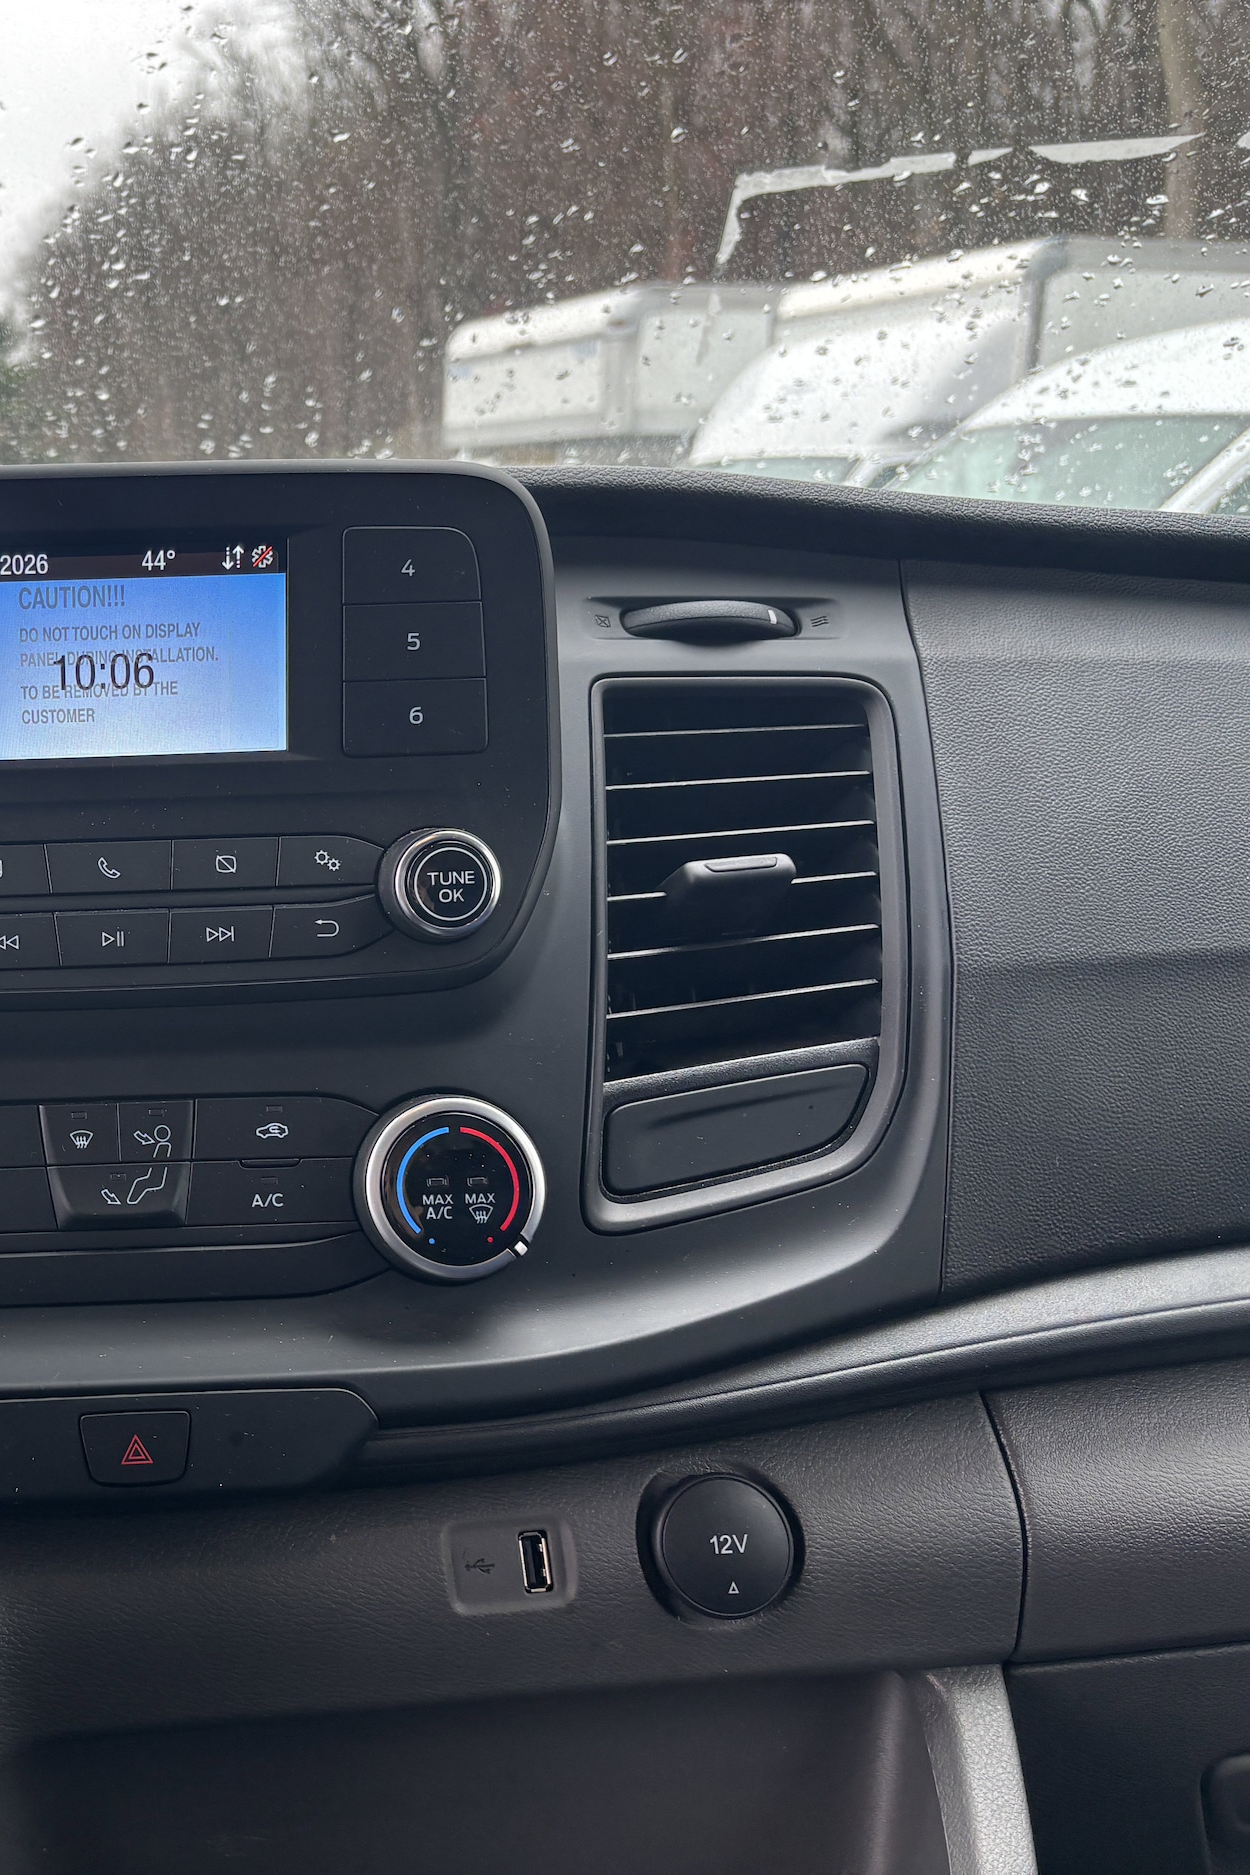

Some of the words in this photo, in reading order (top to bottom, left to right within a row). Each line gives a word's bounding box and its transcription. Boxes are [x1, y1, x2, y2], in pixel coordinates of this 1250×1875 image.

[140, 549, 176, 571] 44°
[400, 558, 416, 577] 4
[18, 585, 126, 610] CAUTION!!!
[19, 627, 39, 643] DO
[43, 626, 70, 642] NOT
[71, 625, 118, 641] TOUCH
[122, 624, 141, 640] ON
[145, 621, 201, 639] DISPLAY
[406, 632, 421, 651] 5
[52, 652, 155, 691] 10:06
[20, 685, 39, 700] TO
[42, 684, 61, 700] BE
[152, 680, 179, 696] THE
[21, 708, 95, 725] CUSTOMER
[408, 706, 424, 725] 6
[426, 869, 476, 886] TUNE
[438, 888, 465, 904] OK
[251, 1192, 285, 1209] A/C
[422, 1193, 454, 1206] MAX
[464, 1192, 496, 1205] MAX
[425, 1206, 453, 1221] A/C
[709, 1533, 749, 1556] 12V
